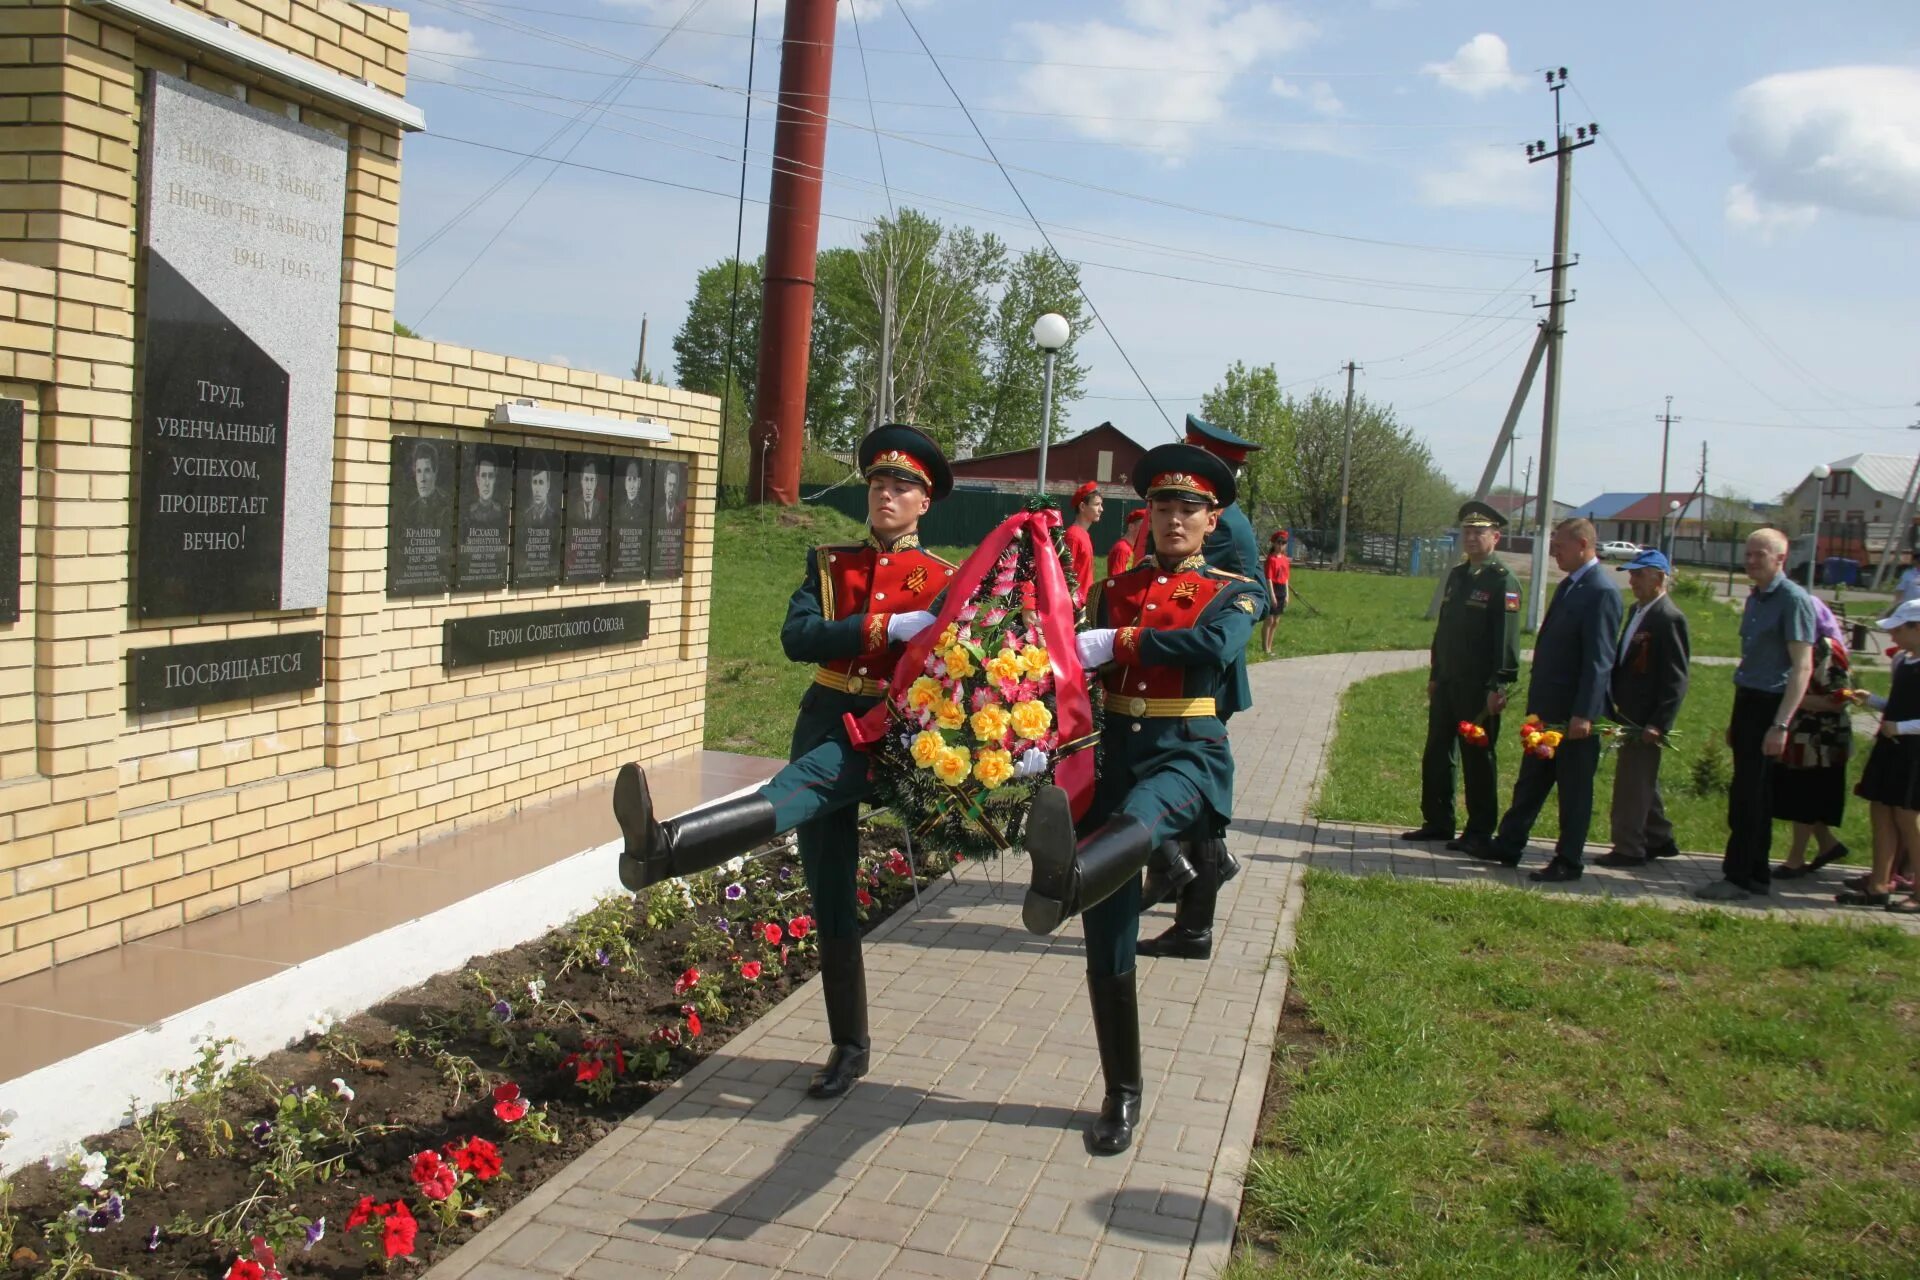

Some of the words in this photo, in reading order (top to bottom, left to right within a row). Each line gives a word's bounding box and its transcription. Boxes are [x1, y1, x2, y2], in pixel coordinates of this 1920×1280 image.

[248, 163, 270, 186] НЕ
[168, 183, 233, 218] НИЧТО
[238, 203, 261, 227] НЕ
[267, 212, 332, 245] ЗАБЫТО!
[232, 246, 266, 270] 1941
[281, 257, 311, 280] 1945
[197, 380, 244, 408] ТРУД,
[157, 416, 276, 445] УВЕНЧАННЫЙ
[172, 456, 260, 481] УСПЕХОМ,
[159, 494, 269, 517] ПРОЦВЕТАЕТ
[183, 524, 245, 551] ВЕЧНО!
[405, 527, 441, 538] КРАЙНОВ
[488, 628, 522, 647] ГЕРОИ
[527, 620, 591, 642] СОВЕТСКОГО
[593, 616, 625, 633] СОЮЗА
[165, 653, 302, 688] ПОСВЯЩАЕТСЯ
